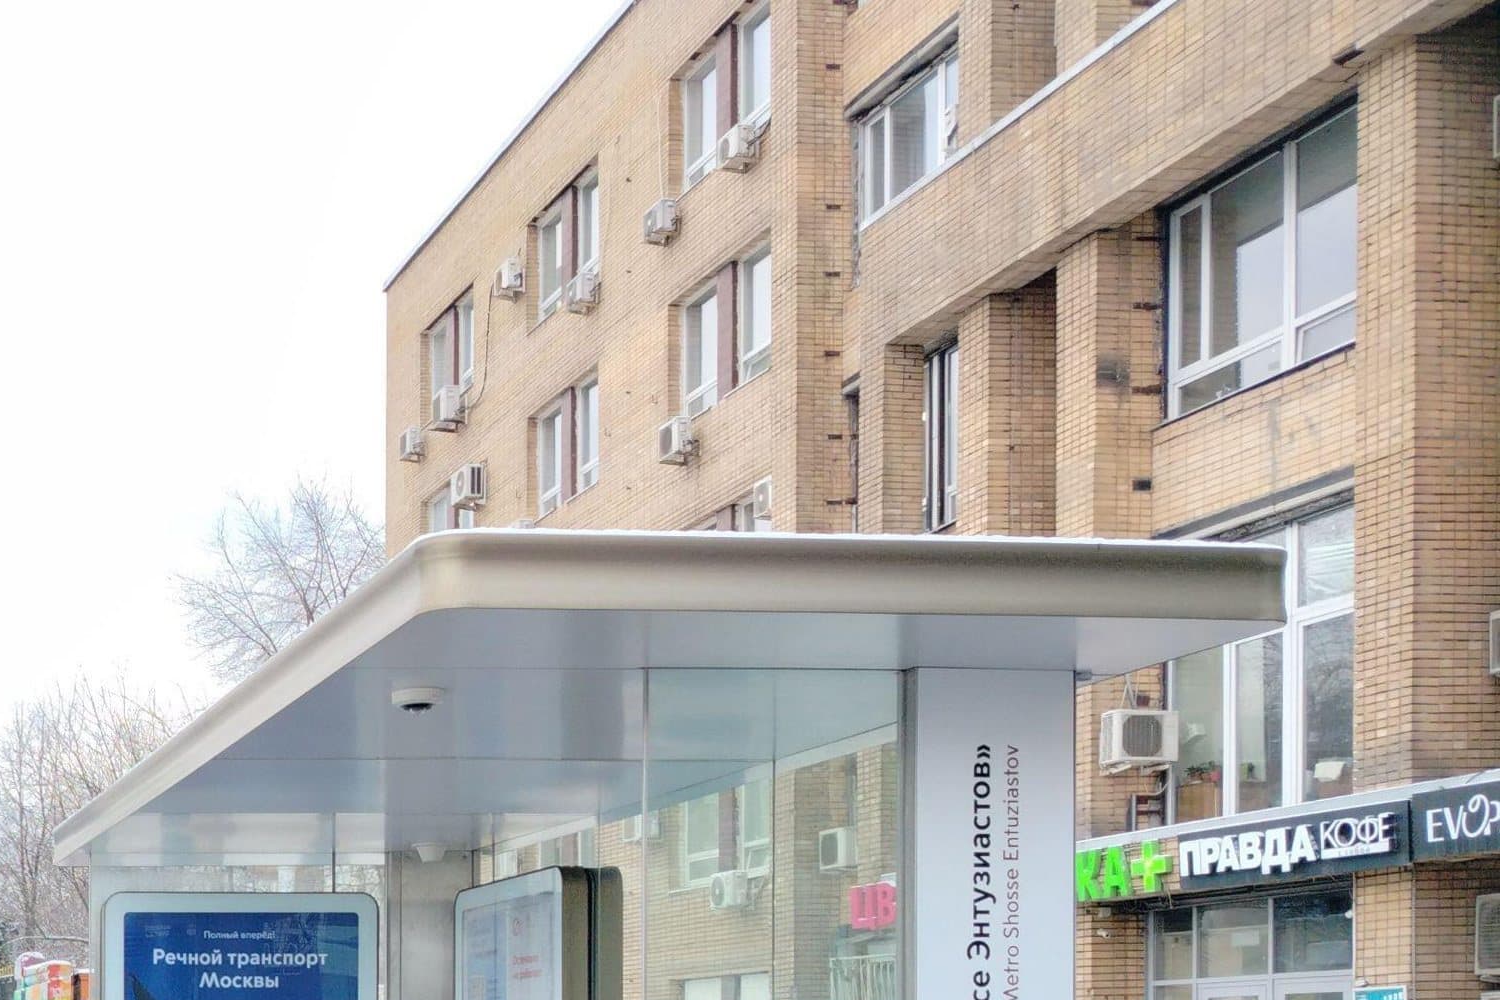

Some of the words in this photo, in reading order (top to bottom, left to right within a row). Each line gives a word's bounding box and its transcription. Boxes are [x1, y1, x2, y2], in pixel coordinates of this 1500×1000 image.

[1002, 744, 1020, 862] Entuziastov
[966, 743, 997, 960] Энтузиастов»
[1179, 823, 1320, 877] ПРАВДА
[1319, 811, 1396, 850] КОФЕ
[203, 930, 239, 940] Полный
[1002, 867, 1020, 939] Shosse
[152, 948, 223, 966] Речной
[227, 952, 329, 969] транспорт
[199, 972, 280, 989] Москвы
